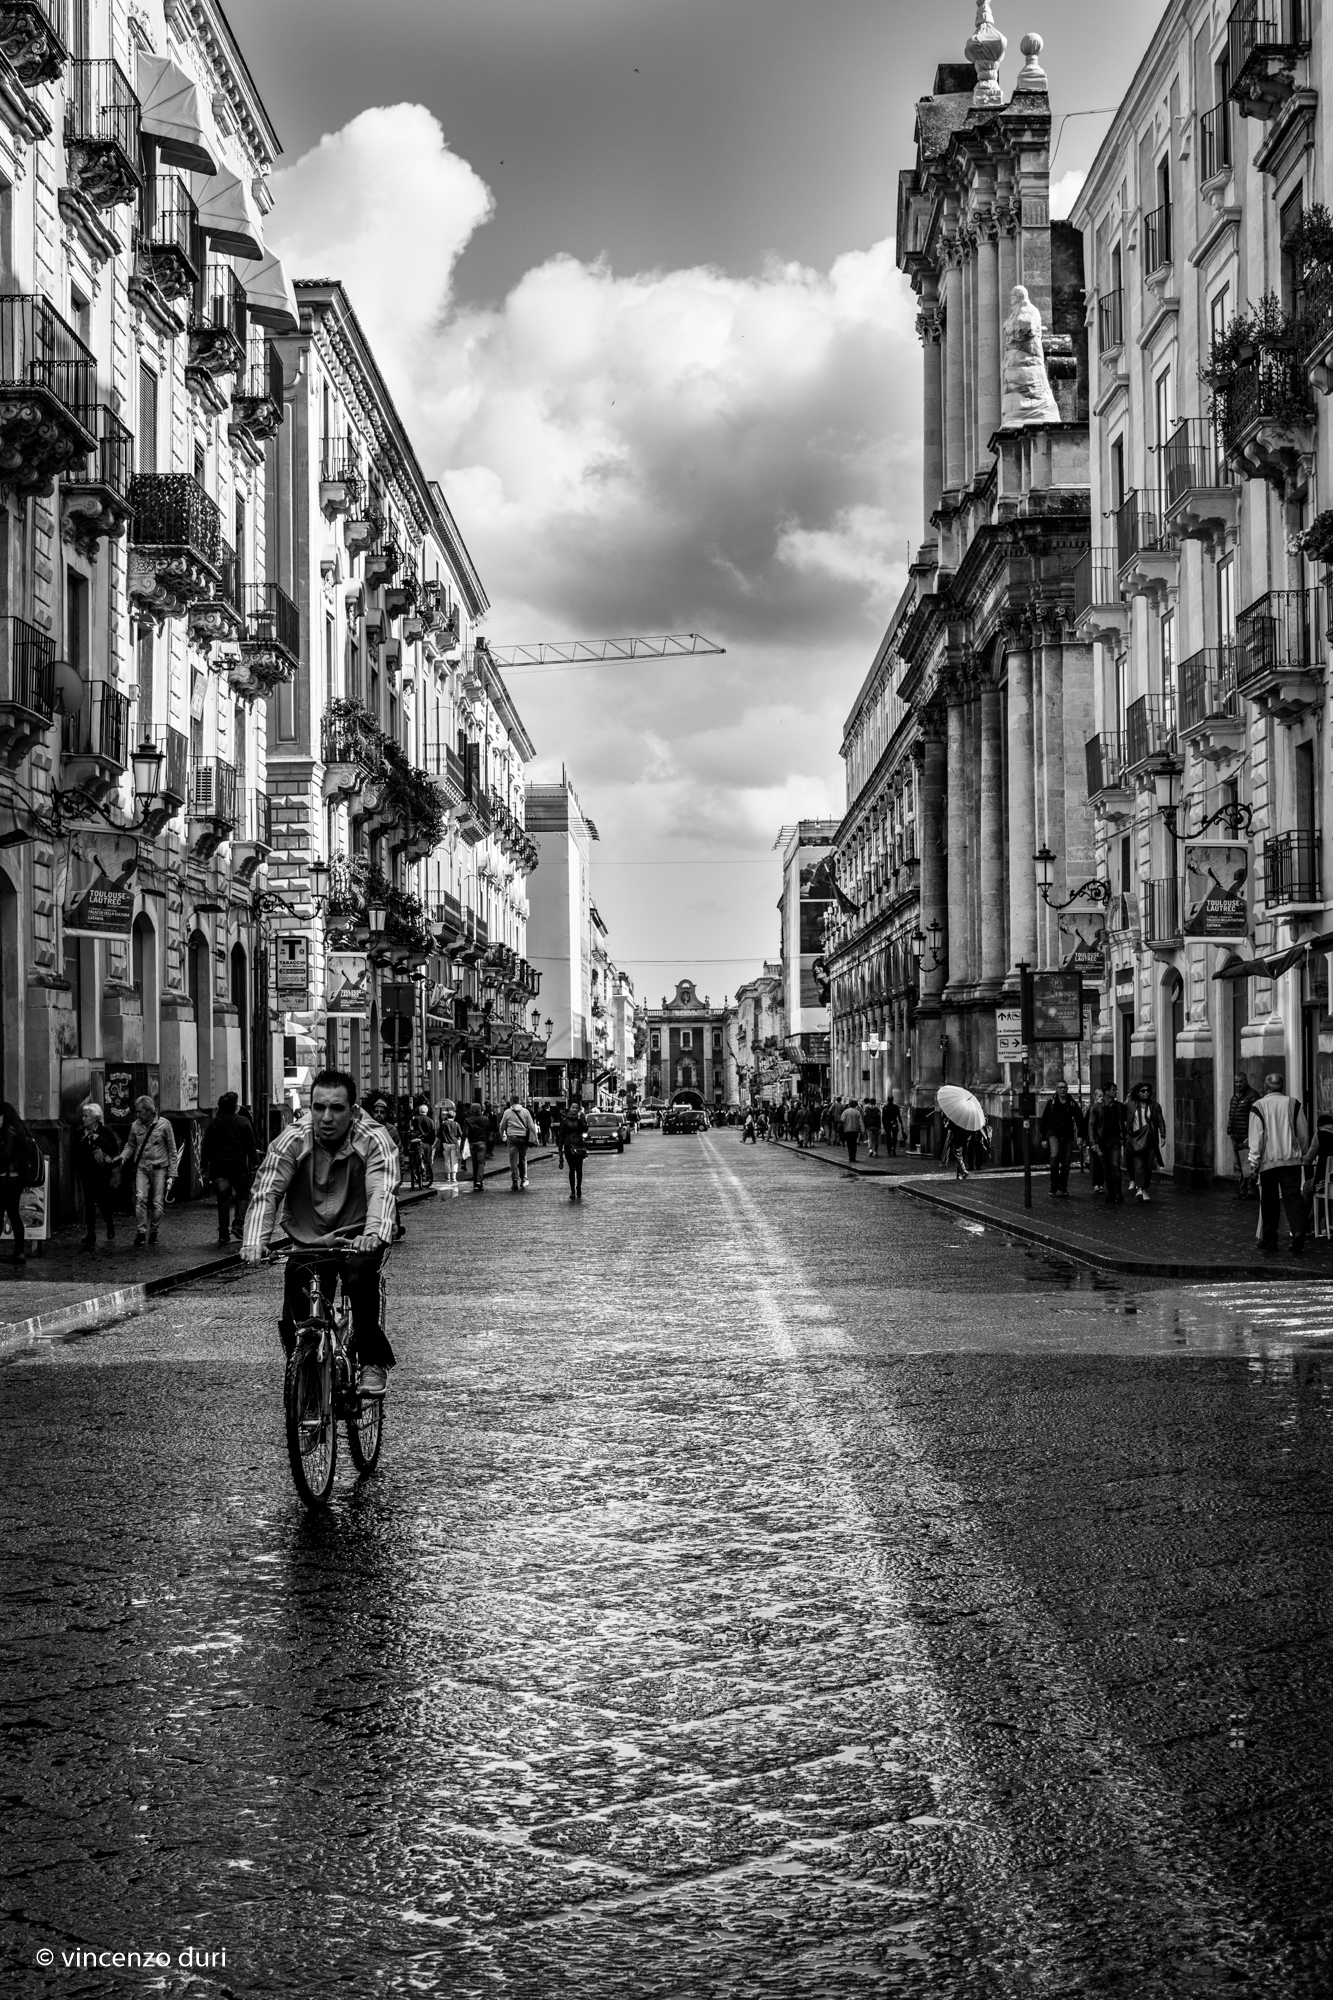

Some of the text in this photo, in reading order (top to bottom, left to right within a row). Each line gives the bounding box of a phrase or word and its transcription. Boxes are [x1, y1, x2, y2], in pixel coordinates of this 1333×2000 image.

[90, 889, 130, 900] TOULOUSE-
[89, 896, 121, 905] LAUTREC
[282, 940, 302, 960] T
